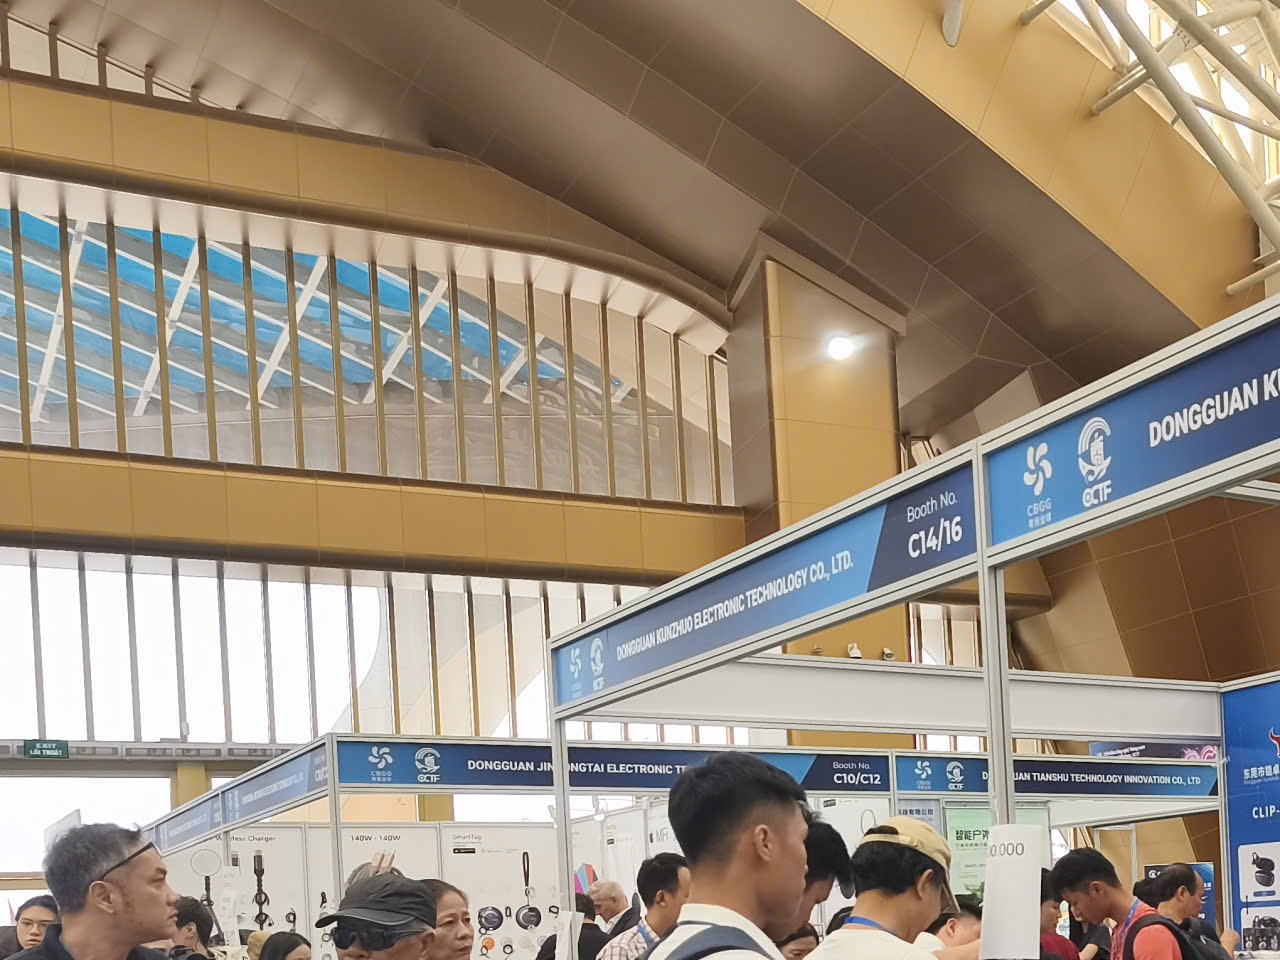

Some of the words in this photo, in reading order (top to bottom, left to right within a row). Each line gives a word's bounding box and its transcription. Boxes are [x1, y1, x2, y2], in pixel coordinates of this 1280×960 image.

[1148, 378, 1259, 448] DONGGUAN
[906, 496, 938, 523] Booth
[940, 491, 958, 507] No.
[907, 515, 963, 558] C14/16
[616, 631, 656, 662] DONGGUAN
[656, 617, 694, 645] KUNZHUO
[693, 594, 746, 630] ELECTRONIC
[745, 569, 808, 609] TECHNOLOGY
[809, 561, 831, 583] CO.,
[831, 550, 854, 576] LTD.
[467, 759, 535, 772] DONGGUAN
[606, 762, 674, 775] ELECTRONIC
[832, 761, 857, 770] Booth
[858, 762, 870, 770] No.
[833, 772, 882, 785] C10/C12
[1031, 771, 1069, 783] TIANSHU
[1069, 773, 1123, 784] TECHNOLOGY
[1123, 774, 1171, 785] INNOVATION
